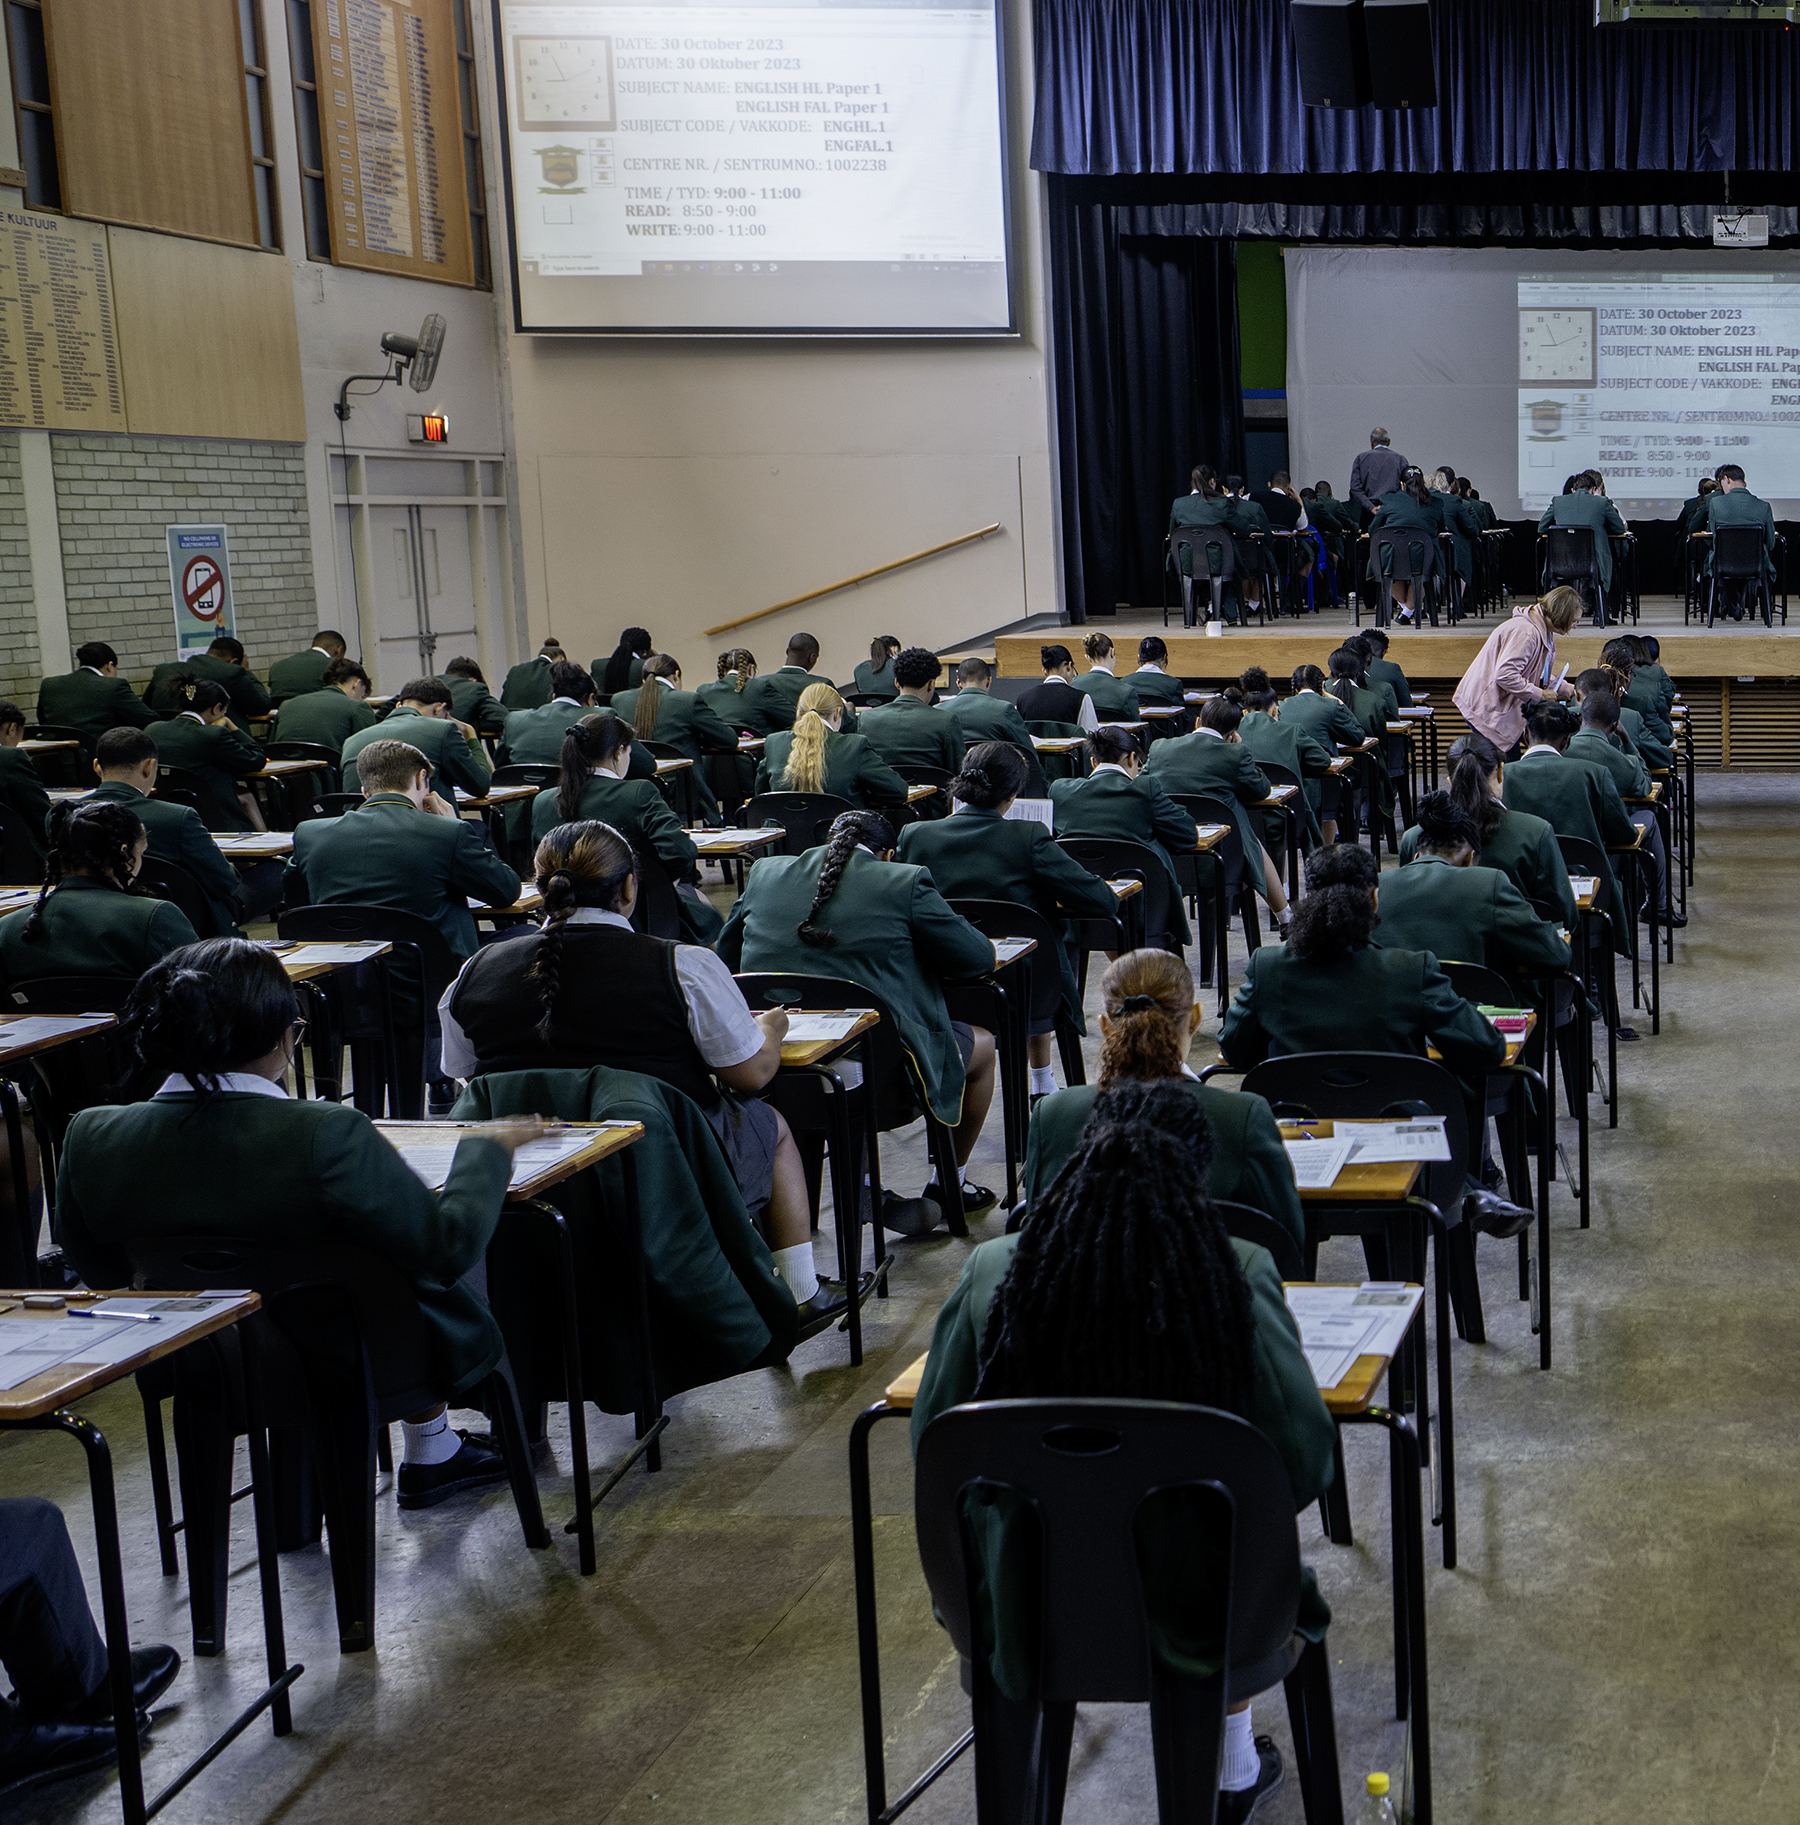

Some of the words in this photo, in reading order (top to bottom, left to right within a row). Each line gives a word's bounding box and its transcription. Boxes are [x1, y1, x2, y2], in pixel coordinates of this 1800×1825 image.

[615, 37, 657, 51] DATE:
[661, 38, 680, 50] 30
[683, 38, 743, 50] October
[747, 39, 784, 51] 2023
[616, 57, 672, 70] DATUM:
[676, 57, 696, 70] 30
[699, 57, 761, 70] Oktober
[764, 58, 801, 70] 2023
[618, 82, 679, 96] SUBJECT
[683, 81, 730, 94] NAME:
[735, 82, 799, 94] ENGLISH
[802, 82, 823, 94] HL
[826, 82, 870, 98] Paper
[873, 83, 882, 94] 1
[736, 101, 800, 113] ENGLISH
[804, 101, 831, 113] FAL
[834, 101, 875, 116] Paper
[882, 102, 889, 113] 1
[621, 119, 682, 134] SUBJECT
[686, 119, 725, 132] CODE
[741, 120, 811, 132] VAKKODE:
[824, 121, 886, 133] ENGHL.1
[825, 140, 893, 152] ENGFAL.1
[622, 158, 681, 171] CENTRE
[685, 158, 709, 170] NR.
[723, 158, 822, 171] SENTRUMNO.:
[827, 159, 887, 171] 1002238
[624, 187, 662, 199] TIME
[676, 187, 710, 199] TYD:
[714, 187, 747, 199] 9:00
[761, 188, 801, 199] 11:00
[625, 205, 670, 217] READ:
[682, 205, 713, 217] 8:50
[726, 205, 757, 217] 9:00
[7, 213, 57, 231] KULTUUR
[626, 224, 681, 236] WRITE:
[683, 224, 714, 236] 9:00
[728, 224, 766, 236] 11:00
[1600, 309, 1635, 320] DATE:
[1638, 309, 1655, 319] 30
[1657, 309, 1708, 319] October
[1710, 309, 1742, 319] 2023
[1600, 325, 1647, 336] DATUM:
[1650, 325, 1667, 335] 30
[1669, 325, 1721, 336] Oktober
[1724, 326, 1756, 336] 2023
[1599, 345, 1653, 358] SUBJECT
[1654, 346, 1694, 356] NAME:
[1698, 346, 1752, 356] ENGLISH
[1755, 346, 1773, 356] HL
[1699, 362, 1753, 372] ENGLISH
[1756, 362, 1780, 372] FAL
[1600, 379, 1653, 391] SUBJECT
[1655, 378, 1688, 389] CODE
[1700, 378, 1763, 389] VAKKODE:
[425, 416, 442, 441] UIT
[1598, 435, 1632, 446] TIME
[1674, 436, 1704, 446] 9:00
[1714, 436, 1750, 446] 11:00
[1647, 450, 1675, 461] 8:50
[1684, 451, 1711, 461] 9:00
[1647, 467, 1675, 477] 9:00
